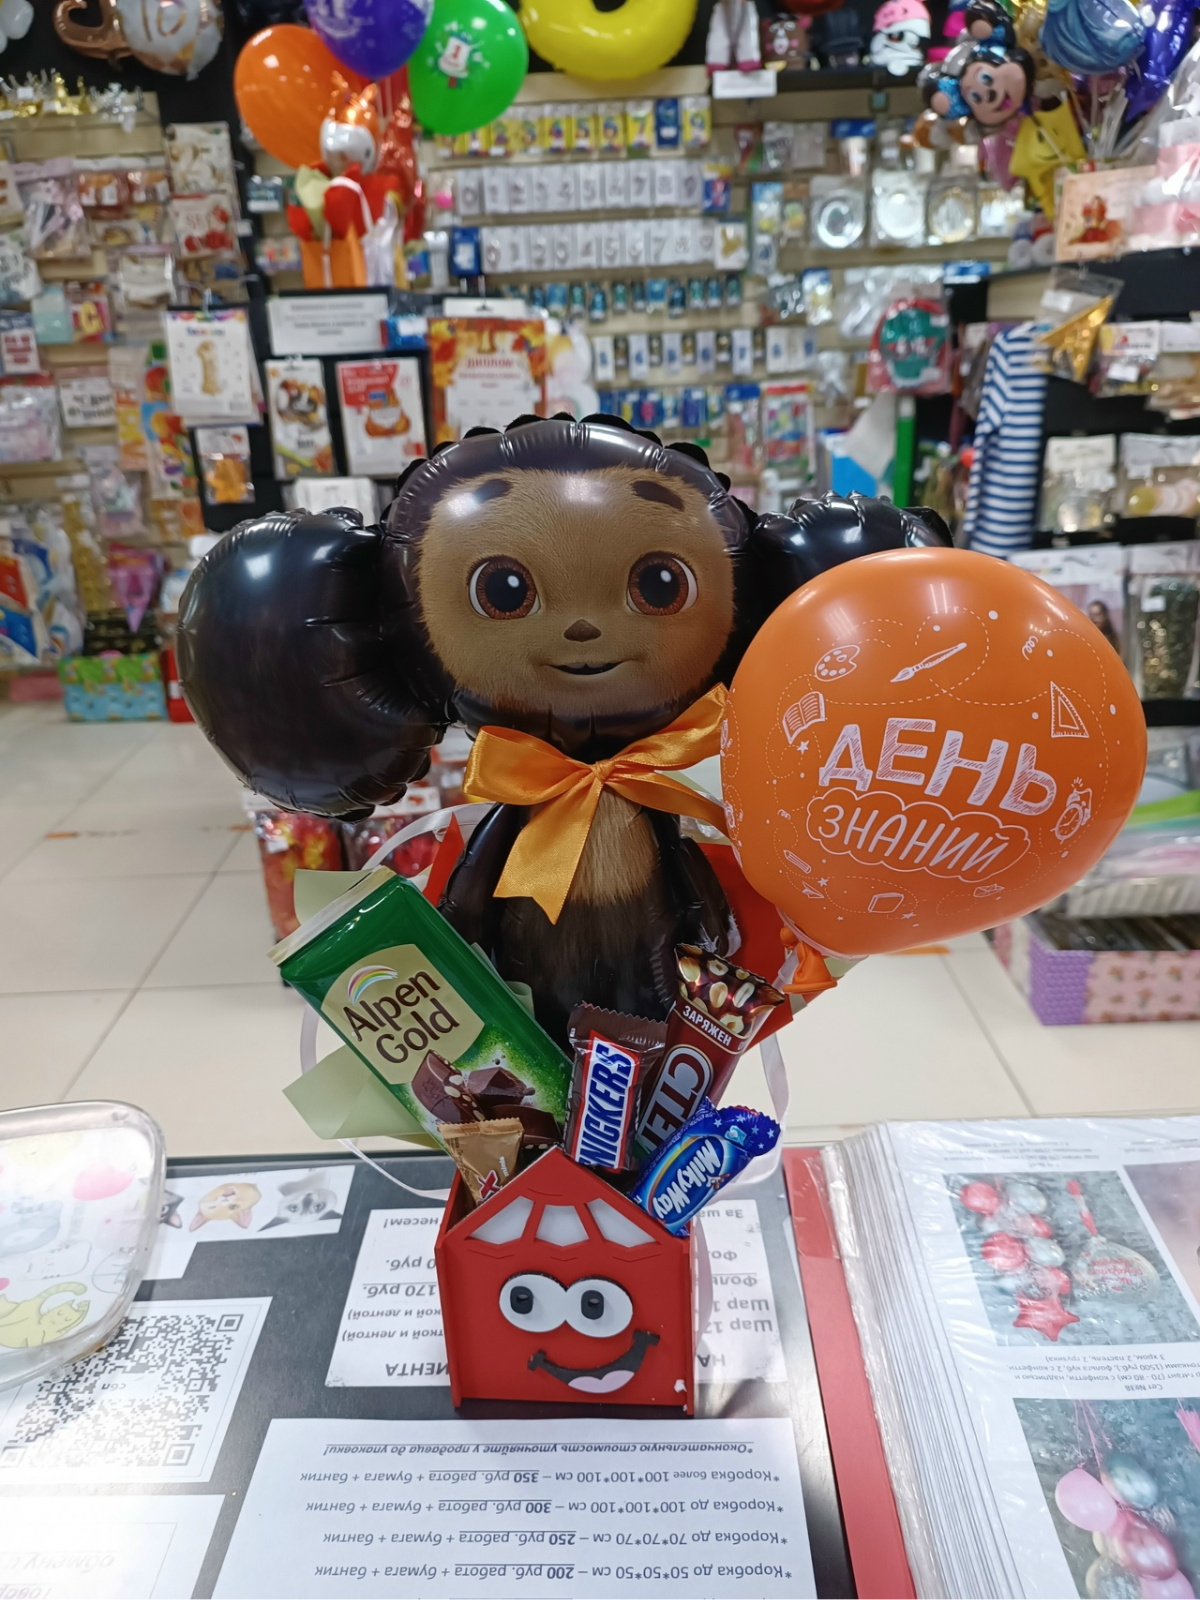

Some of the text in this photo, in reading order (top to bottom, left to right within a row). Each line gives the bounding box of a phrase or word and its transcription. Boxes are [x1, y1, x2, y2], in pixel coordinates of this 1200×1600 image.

[818, 717, 1058, 816] ДЕНЬ
[818, 804, 1011, 873] ЗНАНИЙ
[343, 970, 441, 1042] Alpen
[376, 997, 460, 1064] Gold
[682, 1005, 732, 1047] ЗАРЯЖЕН
[578, 1043, 632, 1168] NICKERS
[383, 1209, 744, 1228] За ша несем!
[708, 1250, 738, 1262] Фо
[385, 1256, 422, 1271] руб.
[362, 1275, 758, 1298] Фоль 170 руб.
[727, 1298, 770, 1312] Шар
[347, 1308, 401, 1320] лентой)
[416, 1308, 441, 1318] кой
[730, 1318, 772, 1333] Шар
[342, 1329, 397, 1342] лентой)
[400, 1330, 408, 1338] и
[413, 1329, 443, 1340] ткой
[385, 1362, 449, 1377] ИЕНТА
[1164, 1362, 1200, 1370] точками
[323, 1444, 388, 1456] упаковки!
[390, 1444, 406, 1456] до
[409, 1443, 470, 1455] продавца
[472, 1444, 480, 1453] у
[483, 1443, 557, 1455] уточняйте
[560, 1444, 636, 1453] стоимость
[300, 1472, 348, 1484] бантик
[364, 1469, 413, 1484] бумага
[429, 1470, 476, 1484] работа
[481, 1469, 510, 1483] руб.
[513, 1471, 540, 1483] 350
[555, 1471, 574, 1480] см
[673, 1470, 707, 1480] более
[305, 1502, 356, 1514] бантик
[372, 1499, 422, 1514] бумага
[438, 1500, 488, 1514] работа
[492, 1500, 522, 1514] руб.
[526, 1502, 552, 1514] 300
[568, 1502, 587, 1511] см
[690, 1498, 709, 1512] до
[323, 1533, 374, 1546] бантик
[391, 1530, 442, 1546] бумага
[459, 1531, 510, 1546] работа
[514, 1531, 545, 1546] руб.
[548, 1532, 576, 1546] 250
[592, 1532, 612, 1543] см
[692, 1529, 710, 1543] до
[314, 1566, 367, 1580] бантик
[384, 1563, 437, 1580] бумага
[454, 1563, 507, 1580] работа
[511, 1563, 543, 1580] руб.
[546, 1566, 574, 1580] 200
[592, 1566, 612, 1577] см
[693, 1562, 713, 1577] до
